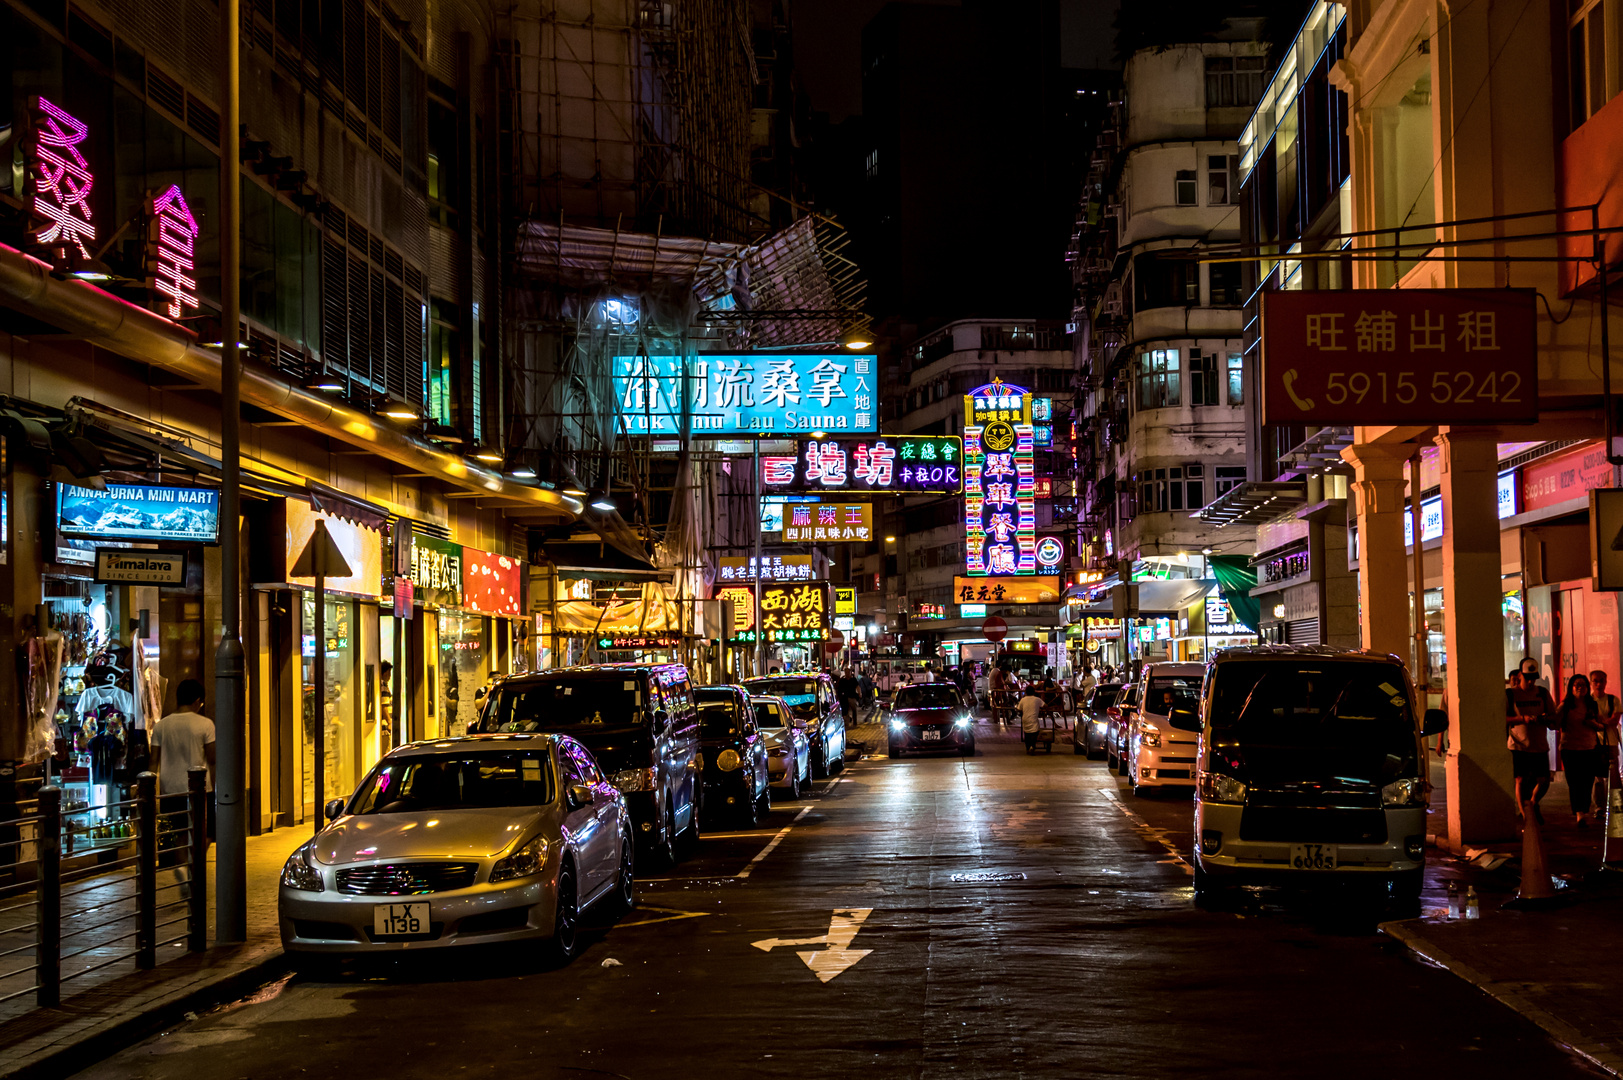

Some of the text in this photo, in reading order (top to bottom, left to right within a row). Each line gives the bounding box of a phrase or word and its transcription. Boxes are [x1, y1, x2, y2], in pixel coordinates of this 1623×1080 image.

[1306, 310, 1501, 352] 旺舖出租
[854, 358, 871, 429] 直入地庫
[1326, 370, 1522, 405] 5915 5242
[622, 410, 848, 430] Yuk hiu Lau Sauna
[900, 441, 958, 461] 夜總會
[148, 489, 175, 503] MINI
[178, 490, 214, 504] MART
[792, 505, 862, 526] 麻辣王
[984, 453, 1017, 575] 翠華餐廳
[786, 527, 869, 540] 四川风味小吃
[107, 554, 172, 572] Himalaya
[106, 572, 140, 580] SINCE
[761, 585, 824, 612] 西湖
[959, 584, 1007, 602] 位元堂
[763, 612, 822, 630] 大酒店
[1293, 855, 1334, 869] 6005
[389, 904, 413, 920] LX
[383, 918, 420, 934] 1138
